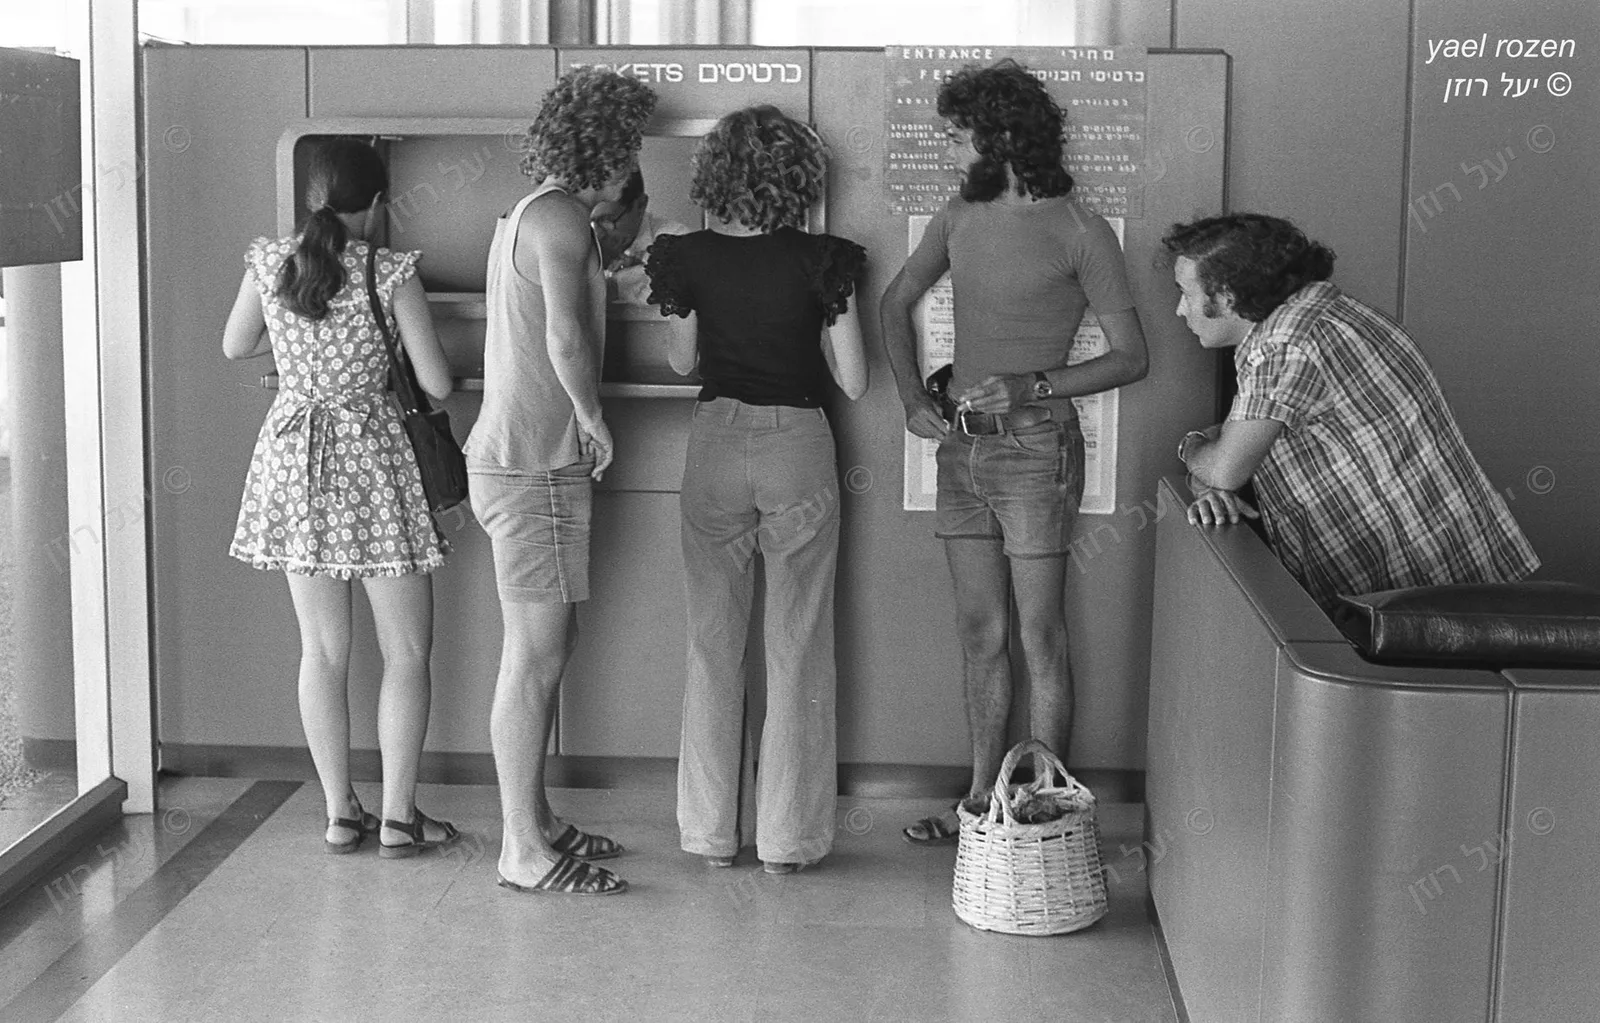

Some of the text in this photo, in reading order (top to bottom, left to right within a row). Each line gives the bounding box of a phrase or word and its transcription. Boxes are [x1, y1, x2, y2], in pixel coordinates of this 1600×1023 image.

[903, 48, 993, 59] ENTRANCE
[570, 63, 683, 83] KETS
[699, 63, 802, 83] כרטיסים
[920, 69, 954, 82] FEE
[1090, 70, 1145, 82] כרטיסי
